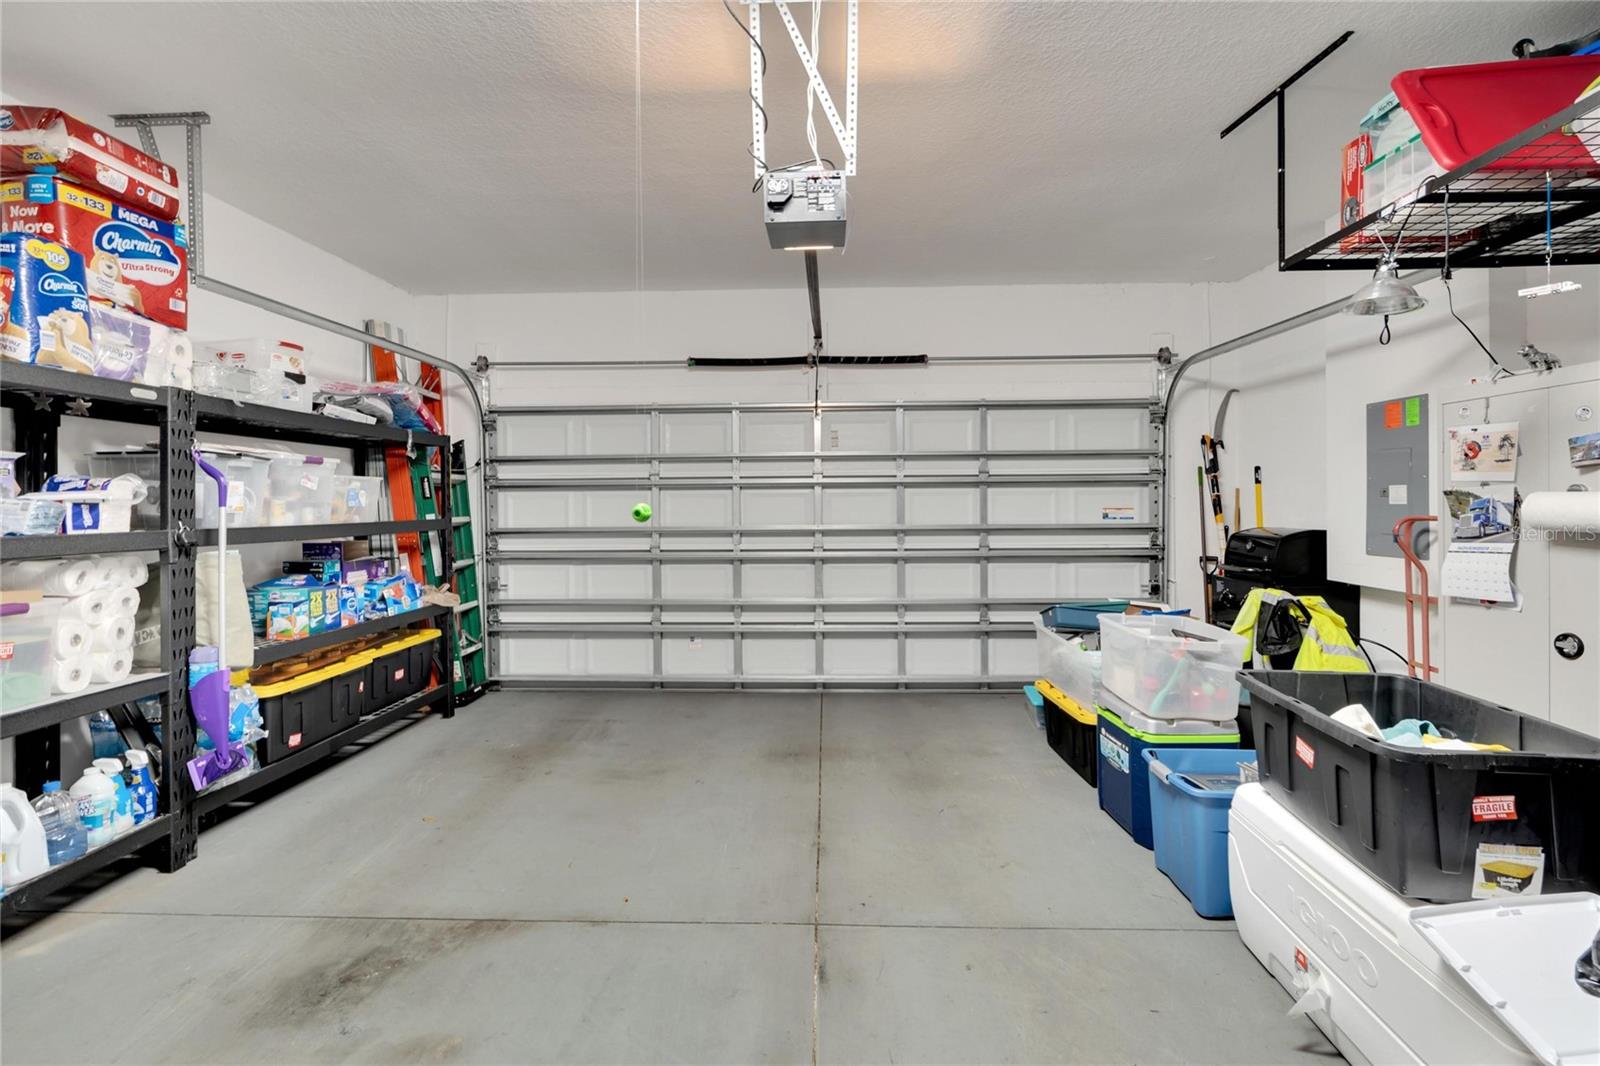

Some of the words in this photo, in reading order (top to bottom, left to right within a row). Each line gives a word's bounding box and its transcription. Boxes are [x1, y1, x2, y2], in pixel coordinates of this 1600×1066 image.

[10, 205, 38, 218] Now
[13, 219, 54, 234] More
[118, 207, 159, 232] MEGA
[101, 231, 162, 257] Charmin
[46, 251, 66, 265] 105
[121, 262, 145, 272] Ultra
[145, 264, 175, 277] Strong
[43, 278, 78, 293] Charmin
[1474, 803, 1513, 813] FRAGILE
